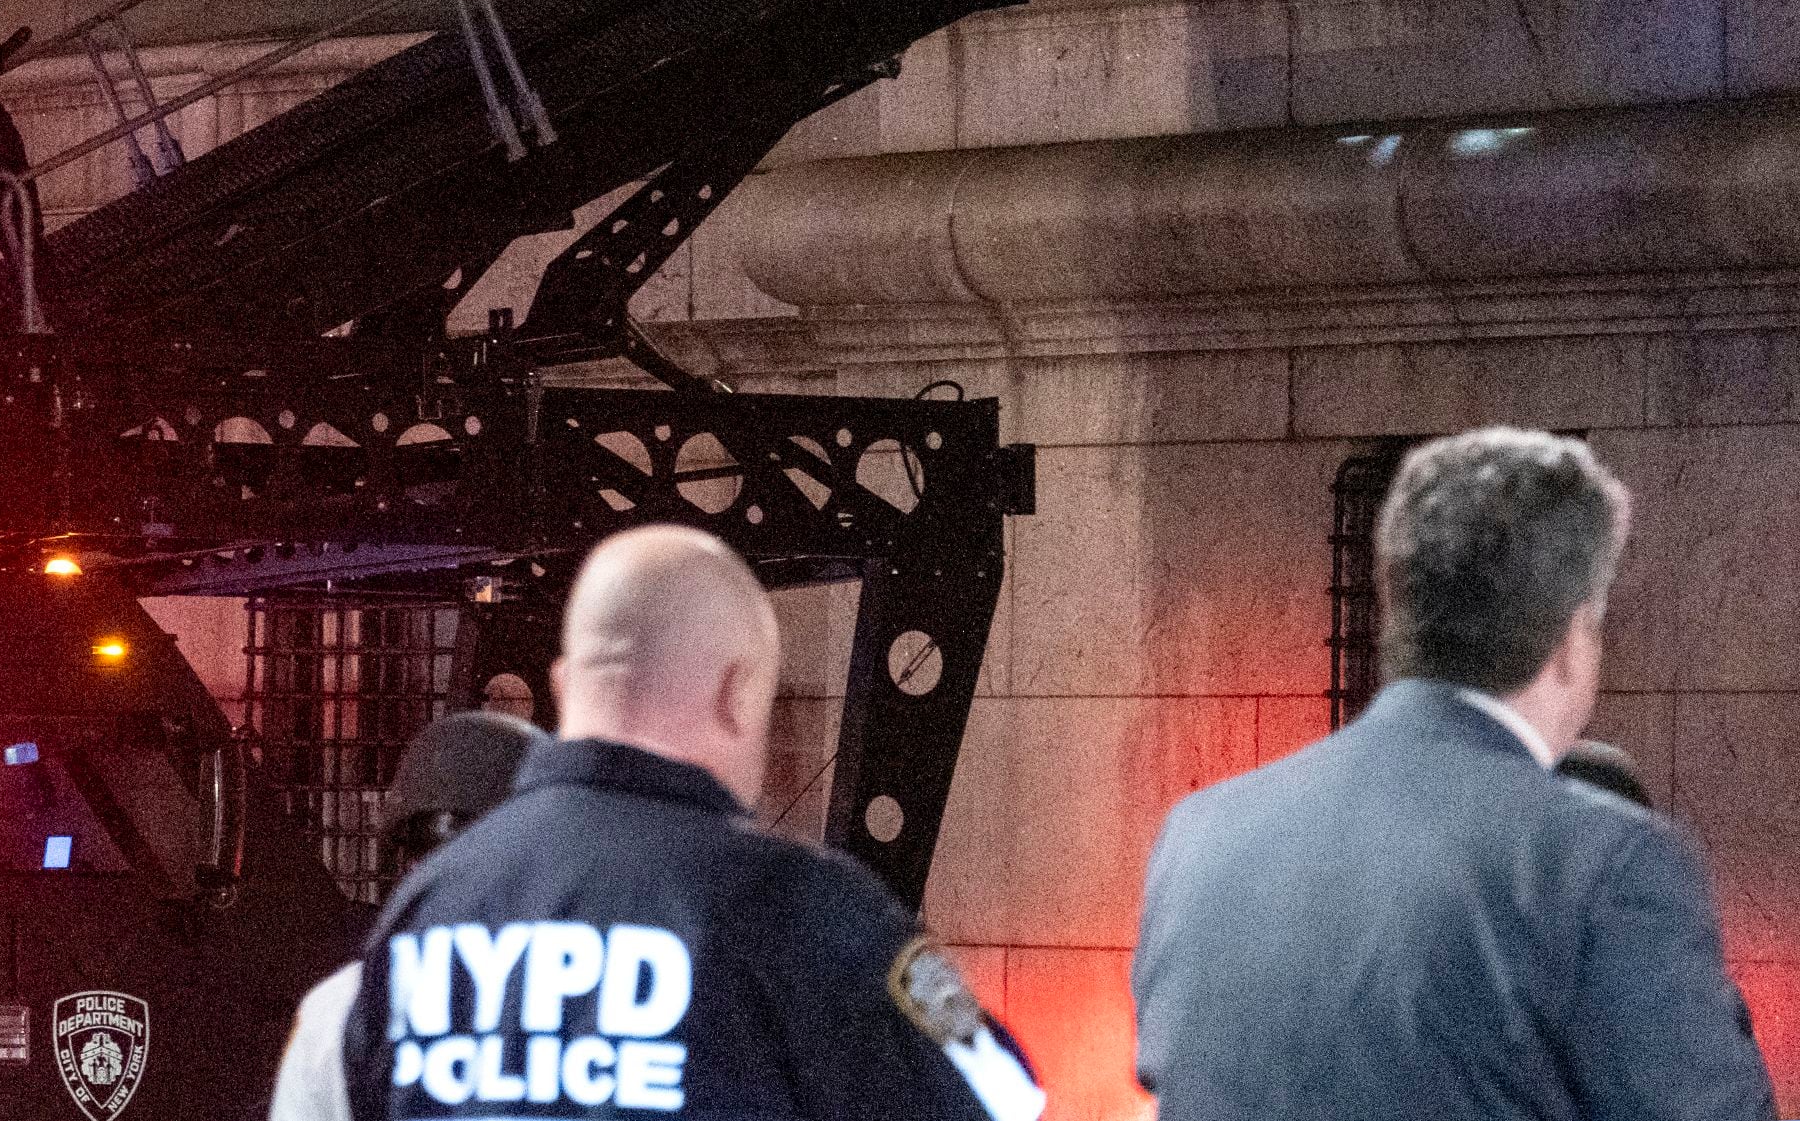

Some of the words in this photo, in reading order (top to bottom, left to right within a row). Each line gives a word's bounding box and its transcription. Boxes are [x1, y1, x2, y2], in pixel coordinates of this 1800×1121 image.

[76, 996, 126, 1014] POLICE
[389, 920, 694, 1040] NYPD
[58, 1011, 144, 1037] DEPARTMENT
[60, 1048, 79, 1082] CITY
[75, 1086, 91, 1104] OF
[107, 1084, 130, 1113] NEW
[126, 1044, 144, 1080] YORK
